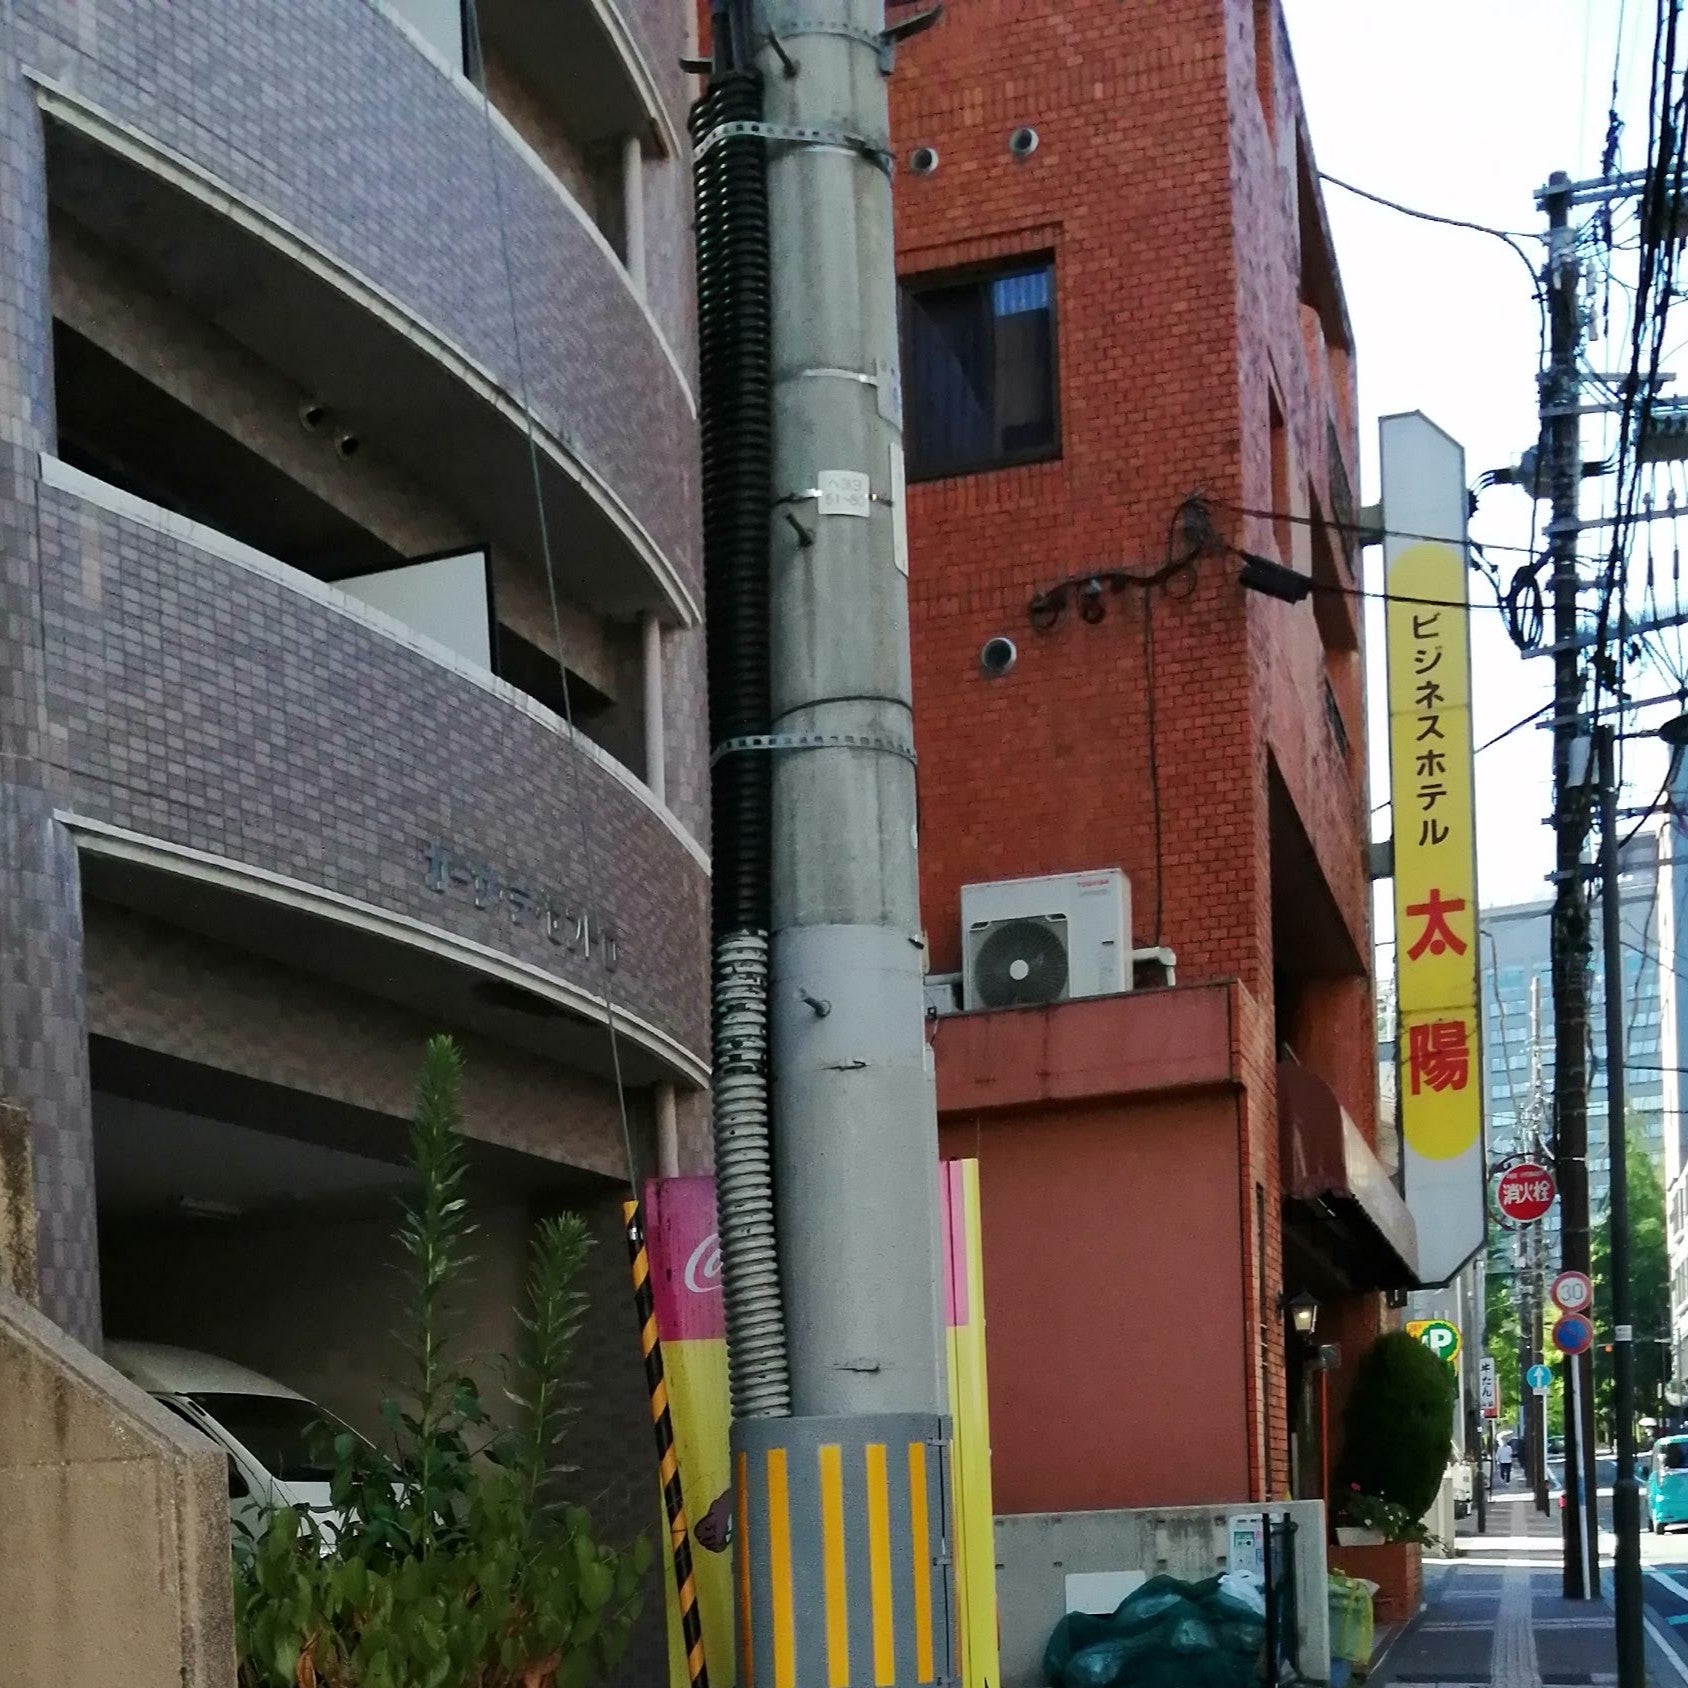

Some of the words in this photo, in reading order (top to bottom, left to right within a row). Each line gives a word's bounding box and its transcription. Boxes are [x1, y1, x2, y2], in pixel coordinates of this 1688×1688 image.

[1413, 612, 1450, 847] ビジネスホテル
[1405, 888, 1470, 1096] 太陽
[1502, 1180, 1551, 1205] 消火栓
[1561, 1283, 1584, 1302] 30
[1430, 1328, 1453, 1358] P
